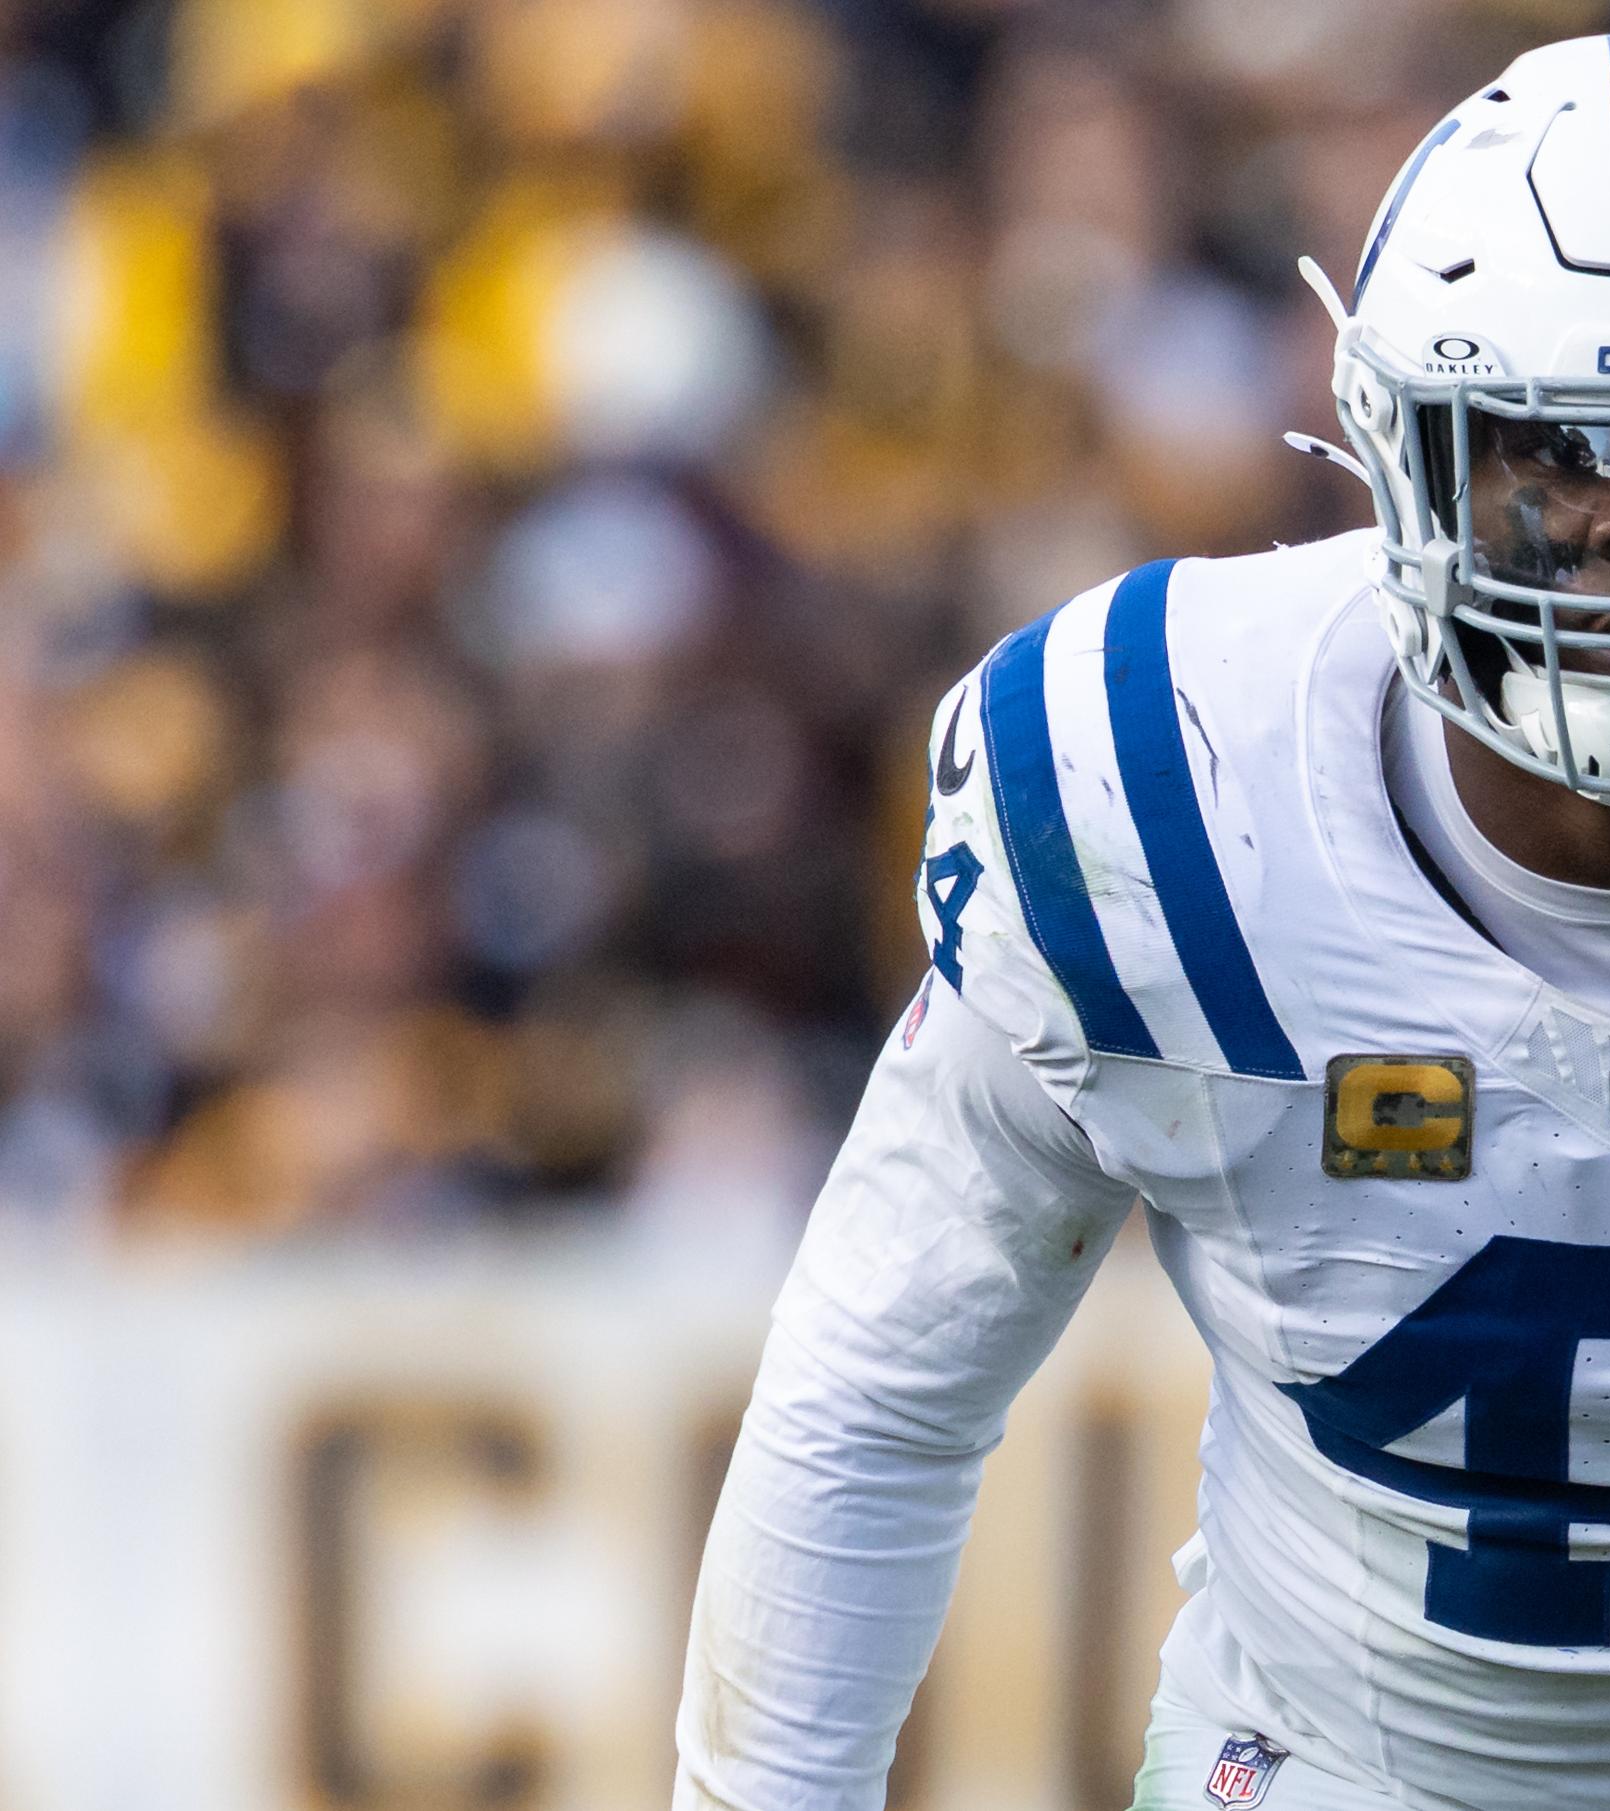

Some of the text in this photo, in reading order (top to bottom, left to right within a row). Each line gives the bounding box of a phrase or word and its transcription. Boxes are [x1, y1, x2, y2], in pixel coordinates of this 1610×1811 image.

[1425, 362, 1495, 375] OAKLEY
[1336, 1064, 1464, 1151] C
[1211, 1763, 1257, 1798] NFL
